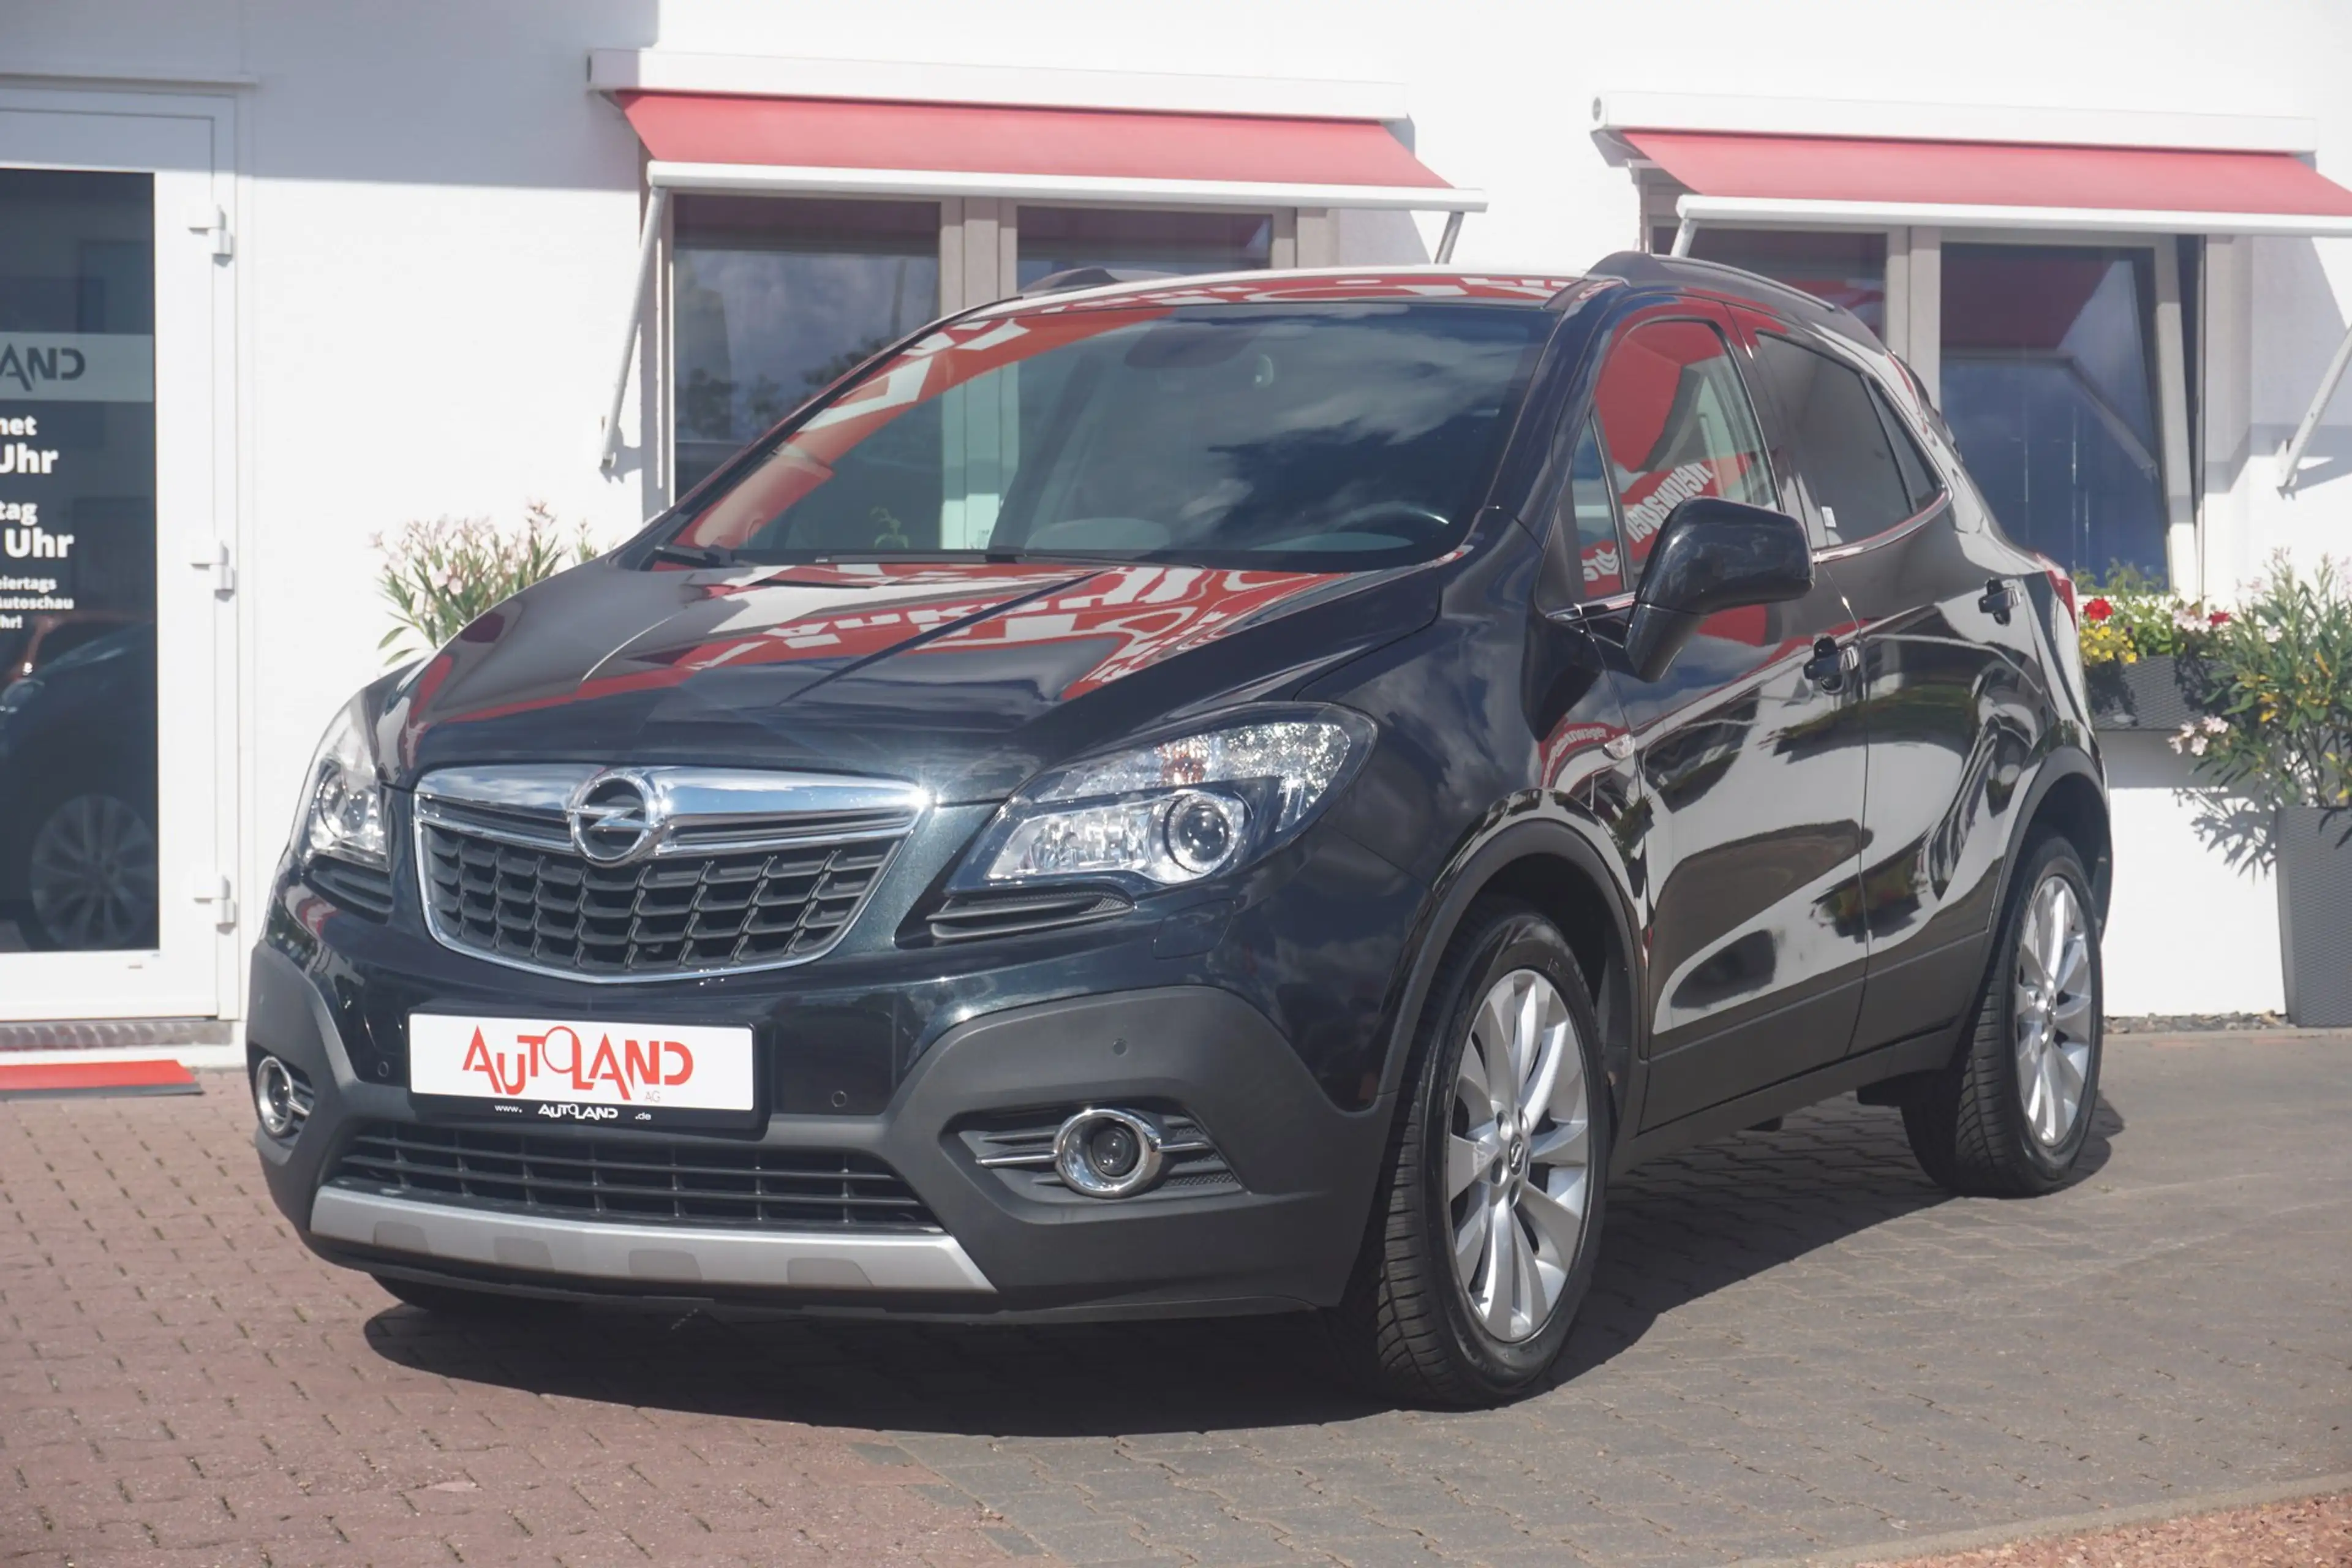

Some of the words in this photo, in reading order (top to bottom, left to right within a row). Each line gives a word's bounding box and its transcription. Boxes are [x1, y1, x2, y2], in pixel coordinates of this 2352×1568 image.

[4, 526, 75, 558] Uhr
[0, 595, 74, 609] utoschau
[644, 1090, 661, 1103] AG
[494, 1104, 522, 1114] www.
[635, 1112, 652, 1121] .de
